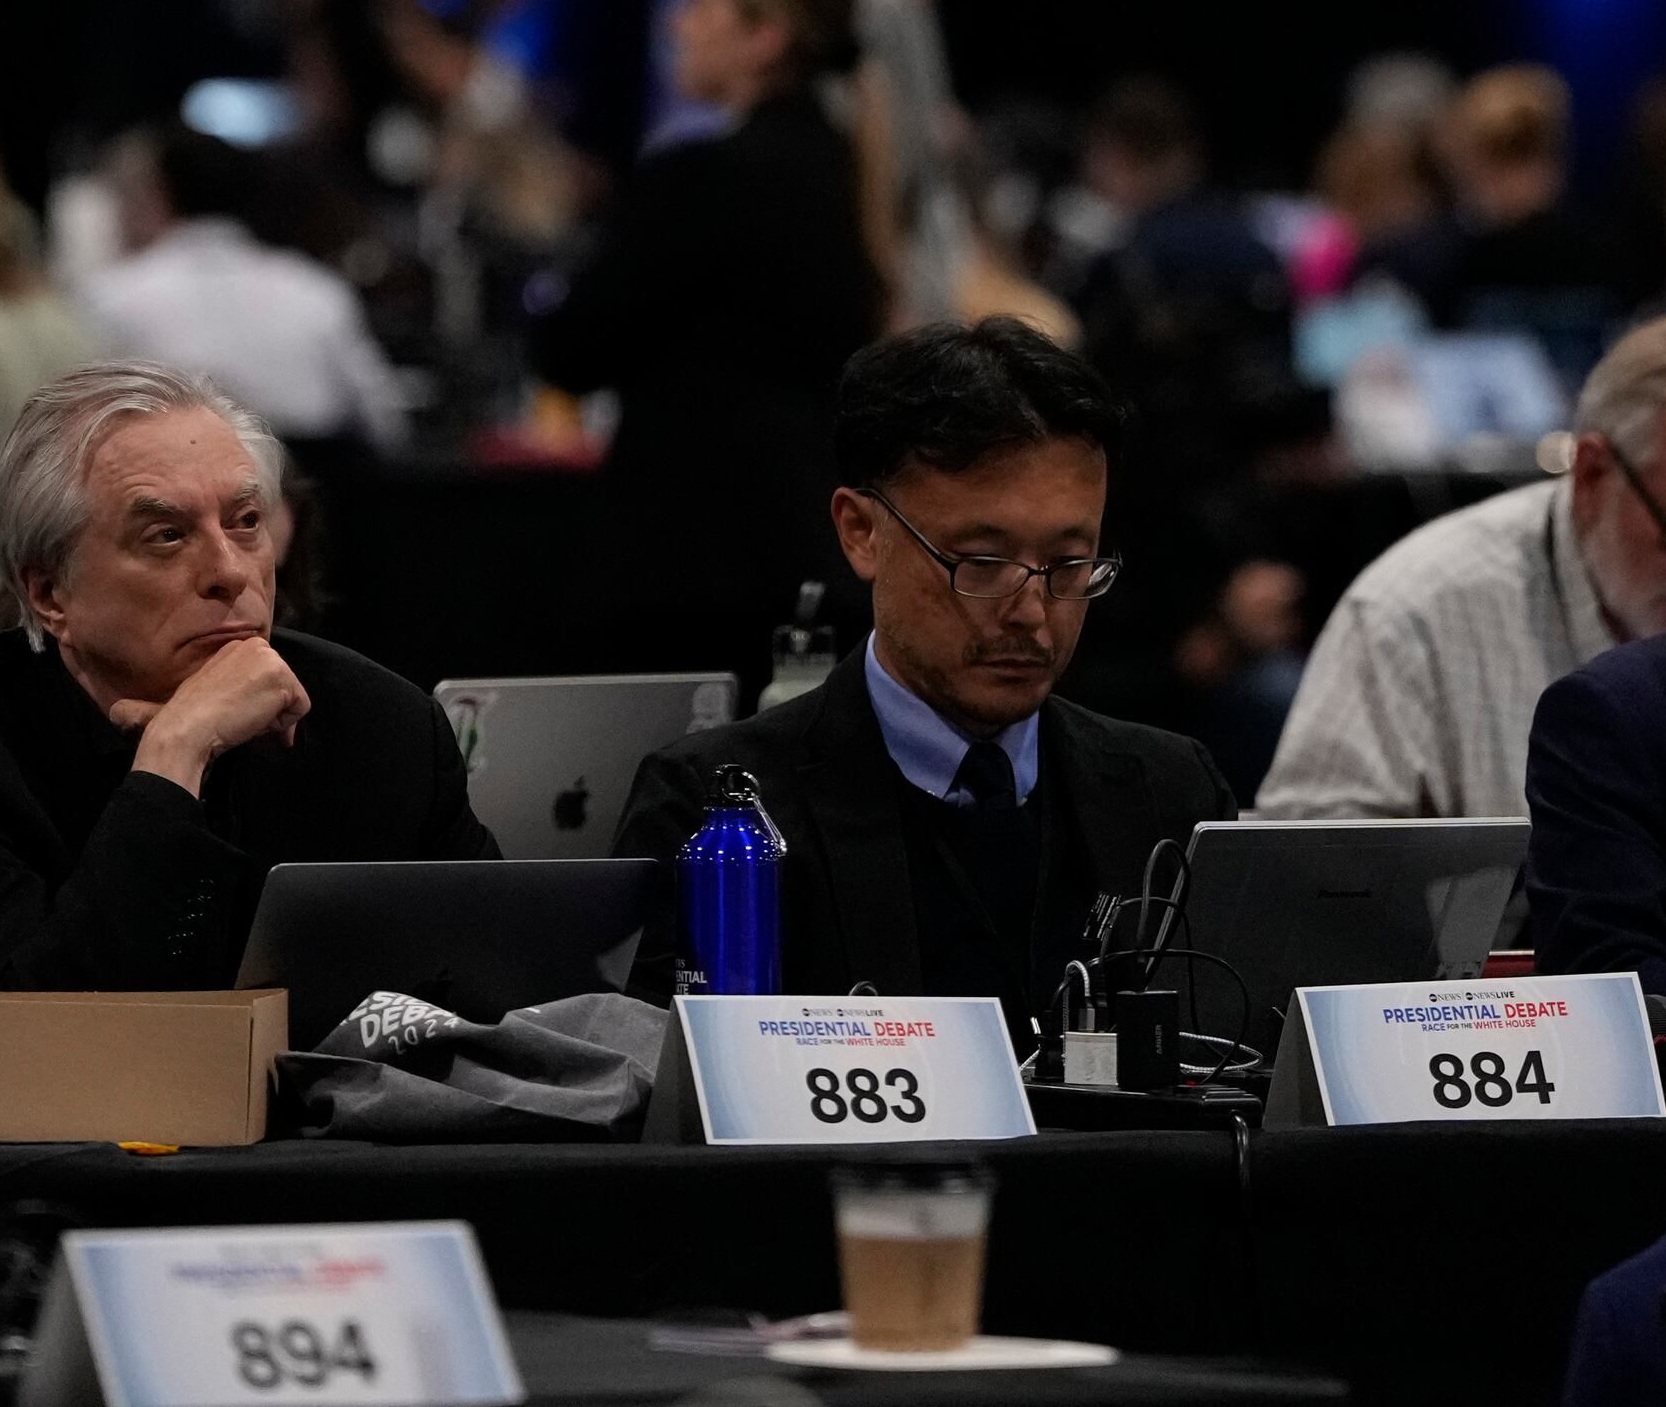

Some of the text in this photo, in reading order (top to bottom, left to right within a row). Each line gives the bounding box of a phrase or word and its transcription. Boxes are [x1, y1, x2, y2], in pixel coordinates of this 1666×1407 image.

[1383, 1001, 1568, 1023] PRESIDENTIAL DEBATE
[1421, 1023, 1446, 1031] RACE
[1474, 1021, 1503, 1030] WHITE
[1505, 1019, 1536, 1028] HOUSE
[388, 1017, 460, 1055] 2024
[759, 1020, 935, 1037] PRESIDENTIAL DEBATE
[796, 1038, 819, 1046] RACE
[845, 1038, 874, 1046] WHITE
[876, 1038, 906, 1046] HOUSE
[1429, 1050, 1555, 1109] 884
[806, 1068, 926, 1124] 883
[231, 1321, 377, 1390] 894
